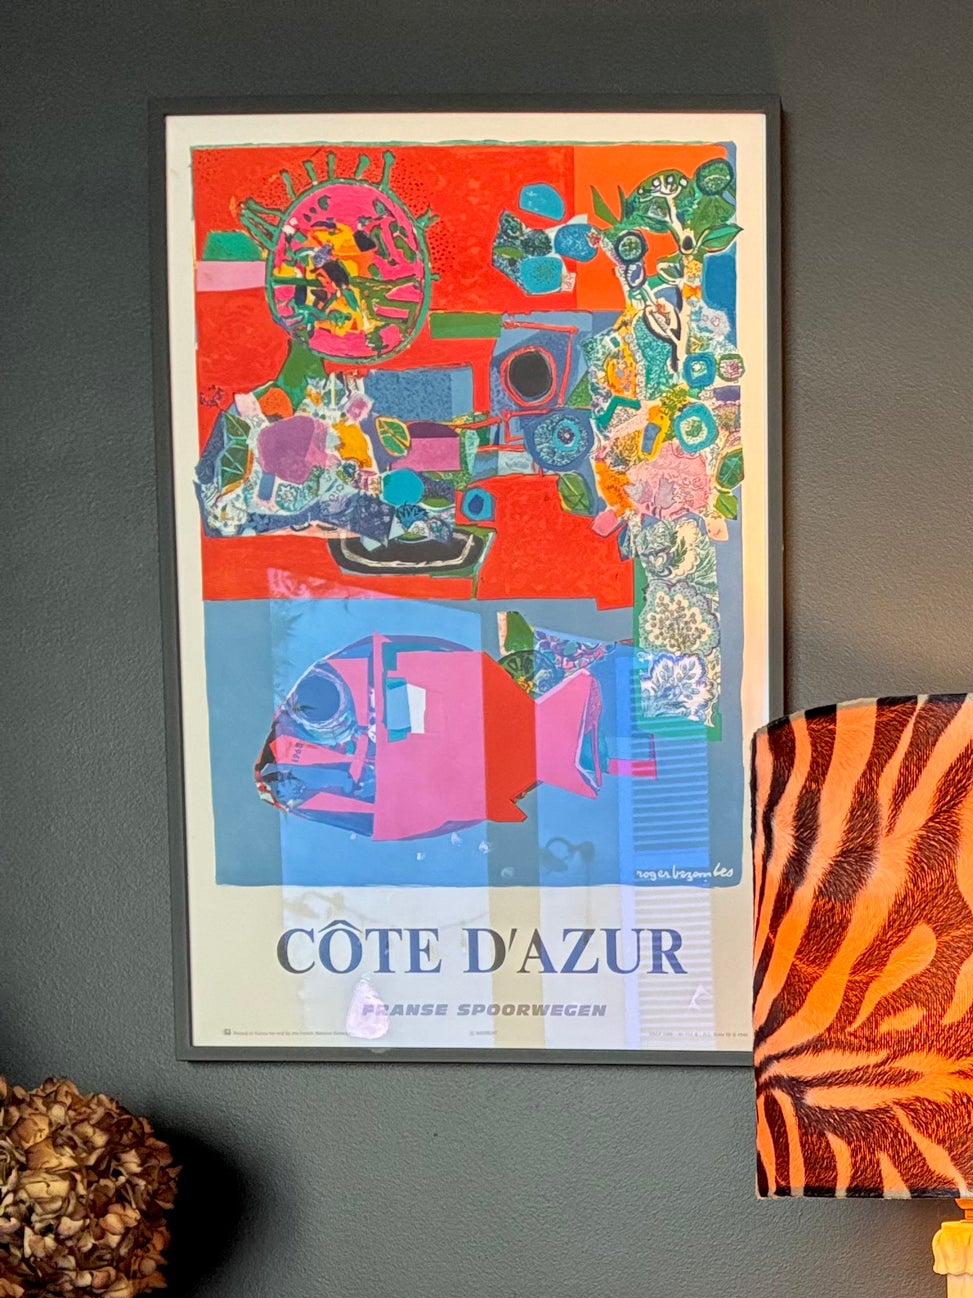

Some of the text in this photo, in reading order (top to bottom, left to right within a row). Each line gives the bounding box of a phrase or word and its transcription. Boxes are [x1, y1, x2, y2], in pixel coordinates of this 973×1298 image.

[276, 919, 688, 975] CÔTE D'AZUR
[361, 1004, 607, 1017] FRANSE SPOORWEGEN
